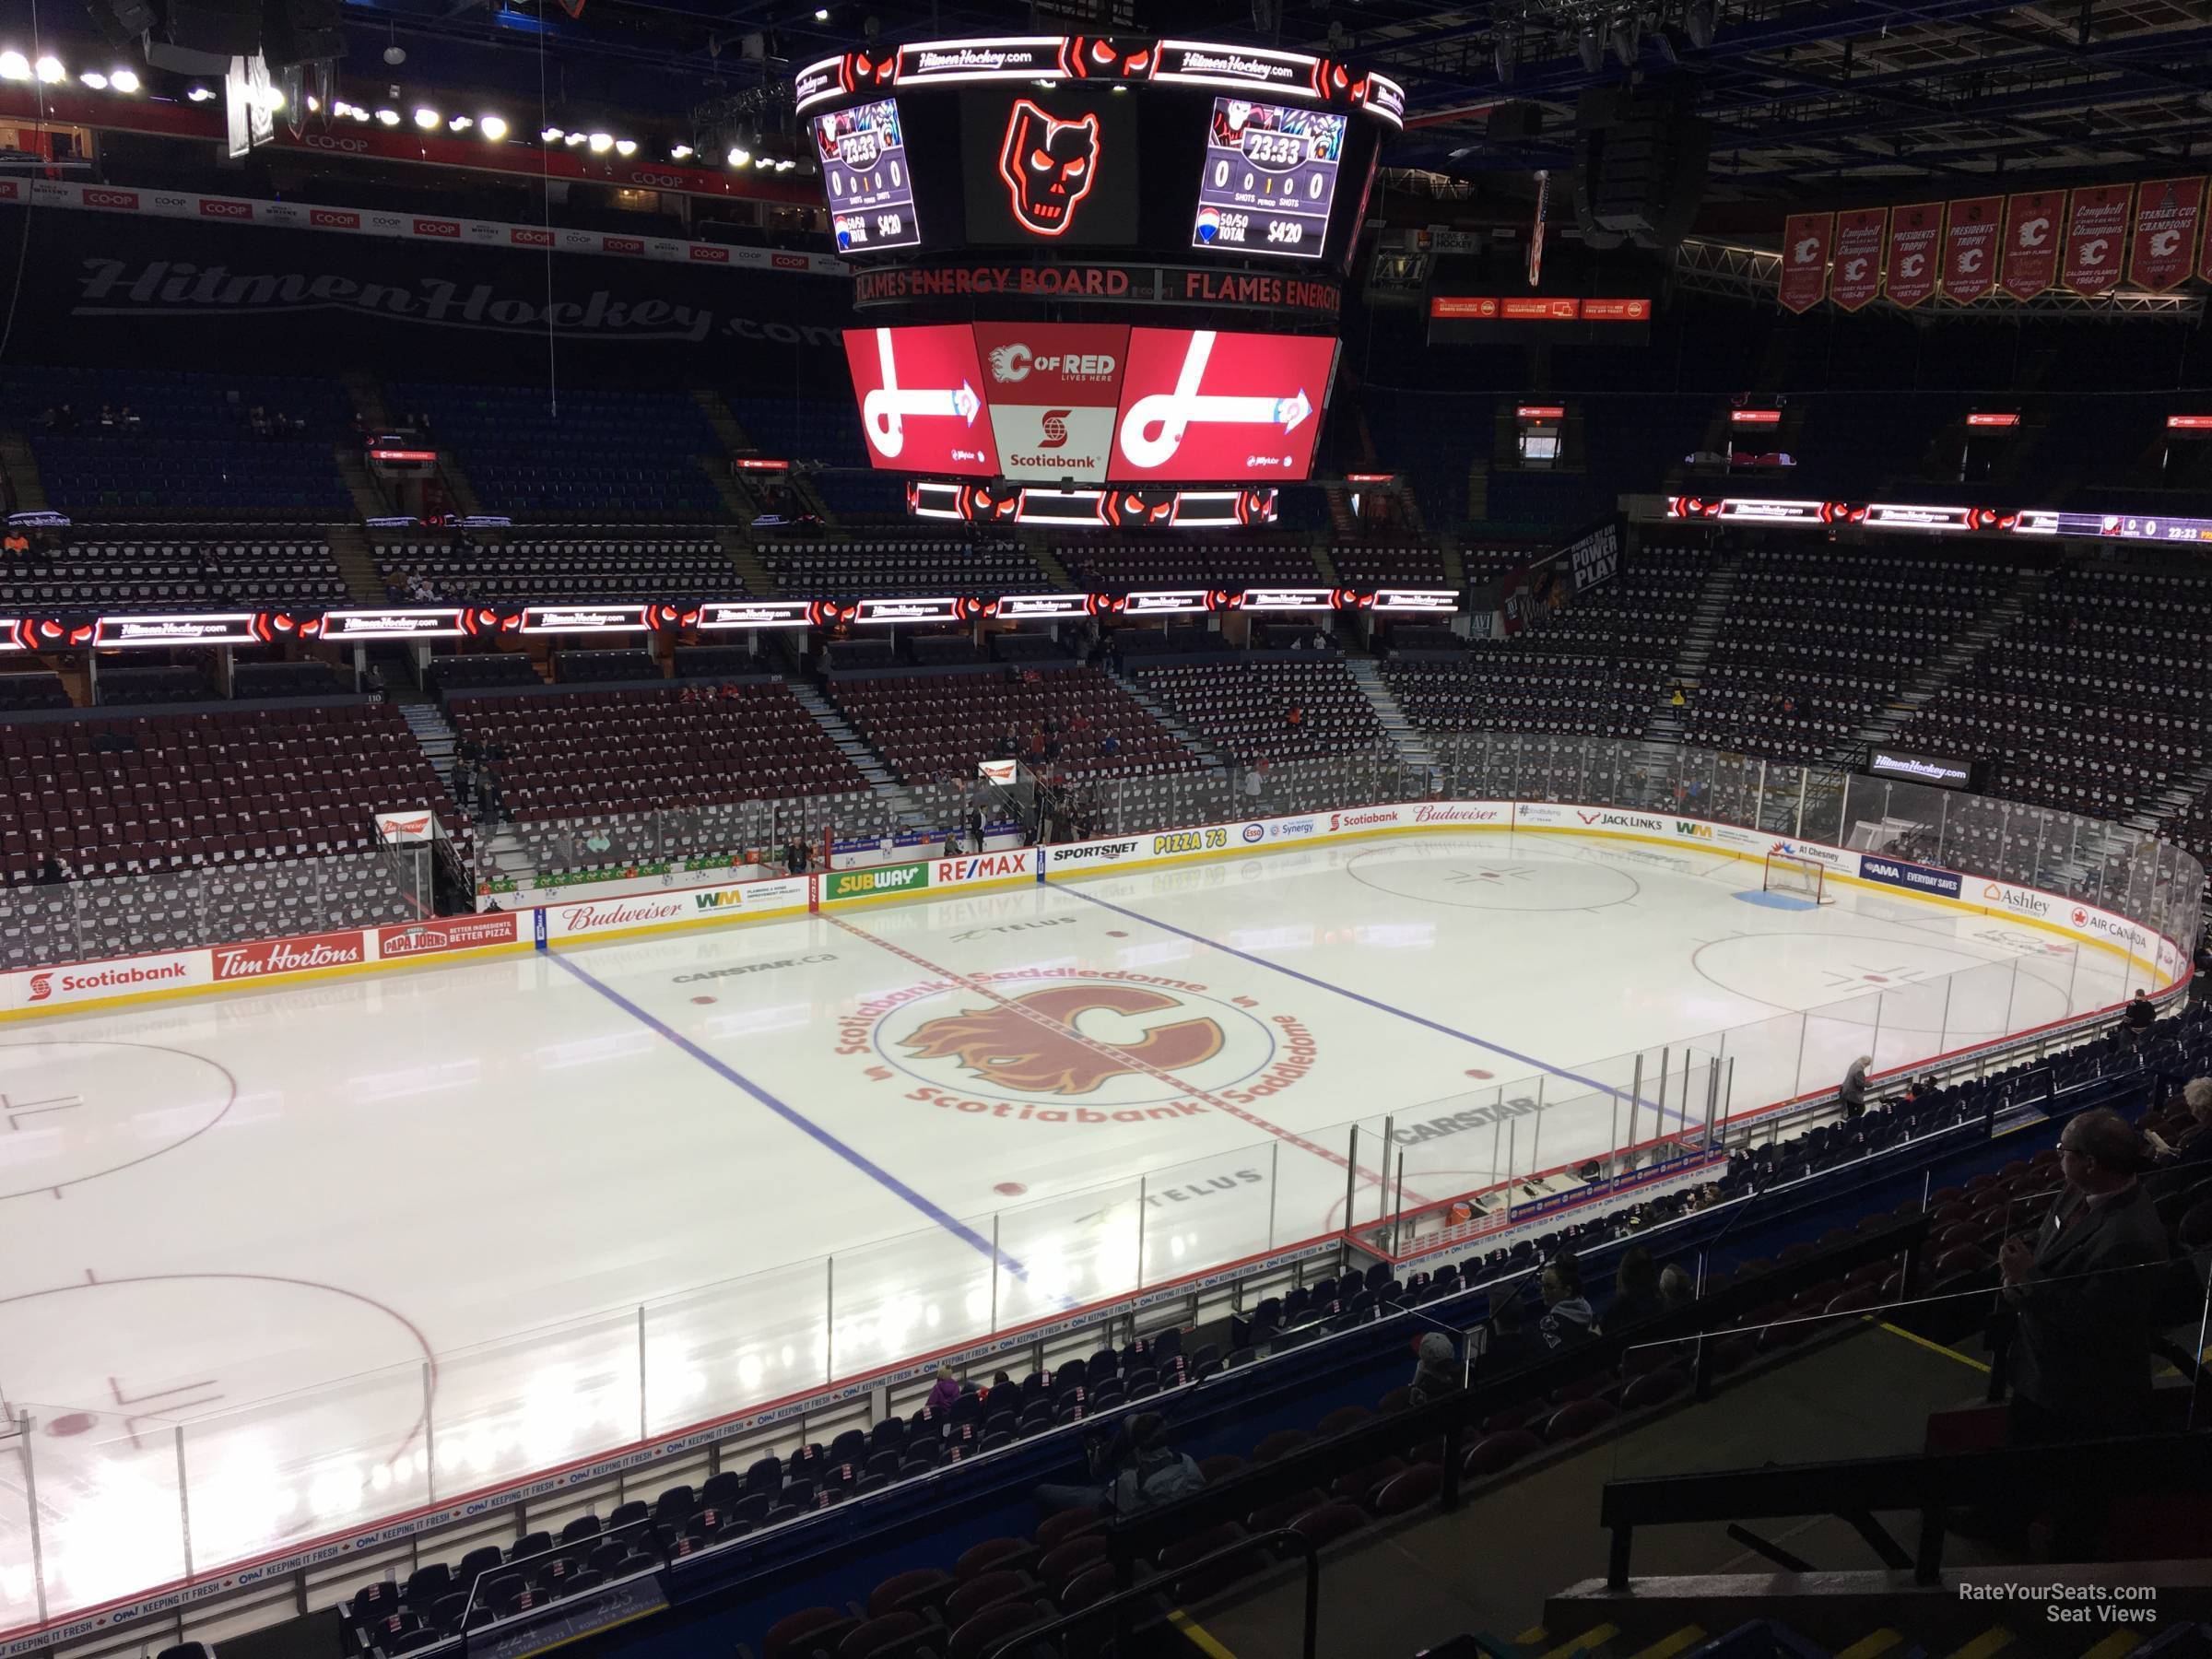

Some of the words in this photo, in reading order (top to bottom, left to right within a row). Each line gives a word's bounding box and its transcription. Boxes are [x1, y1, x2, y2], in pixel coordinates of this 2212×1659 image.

[918, 49, 1032, 73] HitmenHockey.com
[1181, 52, 1293, 79] HitmenHockey.com
[843, 135, 877, 164] 23:33
[1249, 134, 1301, 164] 23:33
[832, 171, 842, 196] 0
[851, 176, 858, 194] 0
[875, 172, 882, 190] 0
[890, 160, 901, 187] 0
[1215, 160, 1230, 187] 0
[1244, 172, 1254, 191] 0
[1284, 178, 1294, 195] 0
[1310, 172, 1324, 199] 0
[88, 193, 133, 205] CO-OP
[1235, 193, 1256, 203] SHOTS
[1279, 197, 1300, 207] SHOTS
[205, 204, 247, 215] CO-OP
[2077, 203, 2125, 218] Campbell
[2139, 208, 2177, 220] STANLEY
[2179, 206, 2198, 218] CUP
[315, 213, 355, 225] CO-OP
[418, 222, 456, 234] CO-OP
[847, 217, 865, 230] 50/50
[877, 214, 901, 238] $420
[1220, 213, 1249, 229] 50/50
[2138, 219, 2194, 232] CHAMPIONS
[1218, 226, 1245, 241] TOTAL
[1267, 220, 1302, 243] $420
[2072, 225, 2124, 237] Champions
[606, 241, 641, 251] CO-OP
[1900, 241, 1927, 252] TROPHY
[1957, 235, 1987, 247] TROPHY
[694, 248, 725, 258] CO-OP
[776, 257, 806, 267] CO-OP
[912, 268, 1011, 295] ENERGY
[1020, 268, 1129, 296] BOARD
[1186, 273, 1281, 303] FLAMES
[1286, 281, 1336, 311] ENERGY
[1034, 356, 1060, 371] OF
[1062, 354, 1116, 375] RED
[1061, 373, 1087, 382] LIVES
[1089, 374, 1112, 382] HERE
[1010, 453, 1095, 468] Scotiabank
[1880, 509, 1950, 524] HitmenHockey.com
[2146, 521, 2157, 535] 0
[1571, 534, 1618, 571] POWER
[1574, 552, 1618, 589] PLAY
[1012, 598, 1073, 612] HitmenHockey.com
[1137, 595, 1193, 608] HitmenHockey.com
[1256, 592, 1317, 606] HitmenHockey.com
[1388, 594, 1450, 606] HitmenHockey.com
[542, 612, 626, 626] HitmenHockey.com
[715, 607, 791, 622] HitmenHockey.com
[871, 604, 939, 618] HitmenHockey.com
[121, 622, 227, 639] HitmenHockey.com
[344, 617, 439, 631] HitmenHockey.com
[1873, 754, 1967, 780] HitmenHockey.com
[1344, 811, 1398, 827] Scotiabank
[1413, 805, 1498, 822] Budweiser
[1601, 813, 1629, 827] JACK
[1282, 823, 1313, 837] Synergy
[1676, 820, 1712, 839] WM
[1053, 841, 1138, 861] SPORTSNET
[1153, 831, 1201, 854] PIZZA
[1205, 830, 1228, 848] 73
[1808, 846, 1840, 863] Chesney
[938, 853, 1027, 882] RE/MAX
[1871, 863, 1900, 878] AMA
[837, 866, 920, 895] SUBWAY
[1907, 872, 1938, 887] EVERYDAY
[1937, 878, 1958, 891] SAVES
[695, 889, 742, 909] WM
[2001, 889, 2051, 917] Ashley
[561, 900, 683, 932] Budweiser
[449, 926, 476, 935] BETTER
[993, 916, 1077, 935] TELUS
[2089, 917, 2108, 932] AIR
[2109, 923, 2147, 948] CANADA
[384, 935, 412, 954] PAPA
[449, 933, 482, 943] BETTER
[484, 928, 512, 939] PIZZA.
[218, 948, 262, 978] Tim
[266, 943, 359, 973] Hortons
[672, 953, 840, 983] CARSTAR.ca
[62, 961, 187, 992] Scotiabank
[968, 967, 1208, 994] Saddledome
[834, 980, 948, 1055] Scotiabank
[1223, 1014, 1317, 1105] Saddledome
[904, 1087, 1211, 1124] Scotiabank
[1146, 1167, 1265, 1209] TELUS
[382, 1524, 415, 1540] KEEPING
[416, 1521, 424, 1531] IT
[426, 1512, 450, 1527] FRESH
[266, 1558, 301, 1575] KEEPING
[302, 1554, 312, 1565] IT
[313, 1547, 338, 1562] FRESH
[143, 1595, 180, 1614] KEEPING
[181, 1591, 190, 1603] IT
[192, 1583, 219, 1600] FRESH
[10, 1634, 50, 1652] KEEPING
[52, 1630, 60, 1642] IT
[64, 1621, 92, 1640] FRESH
